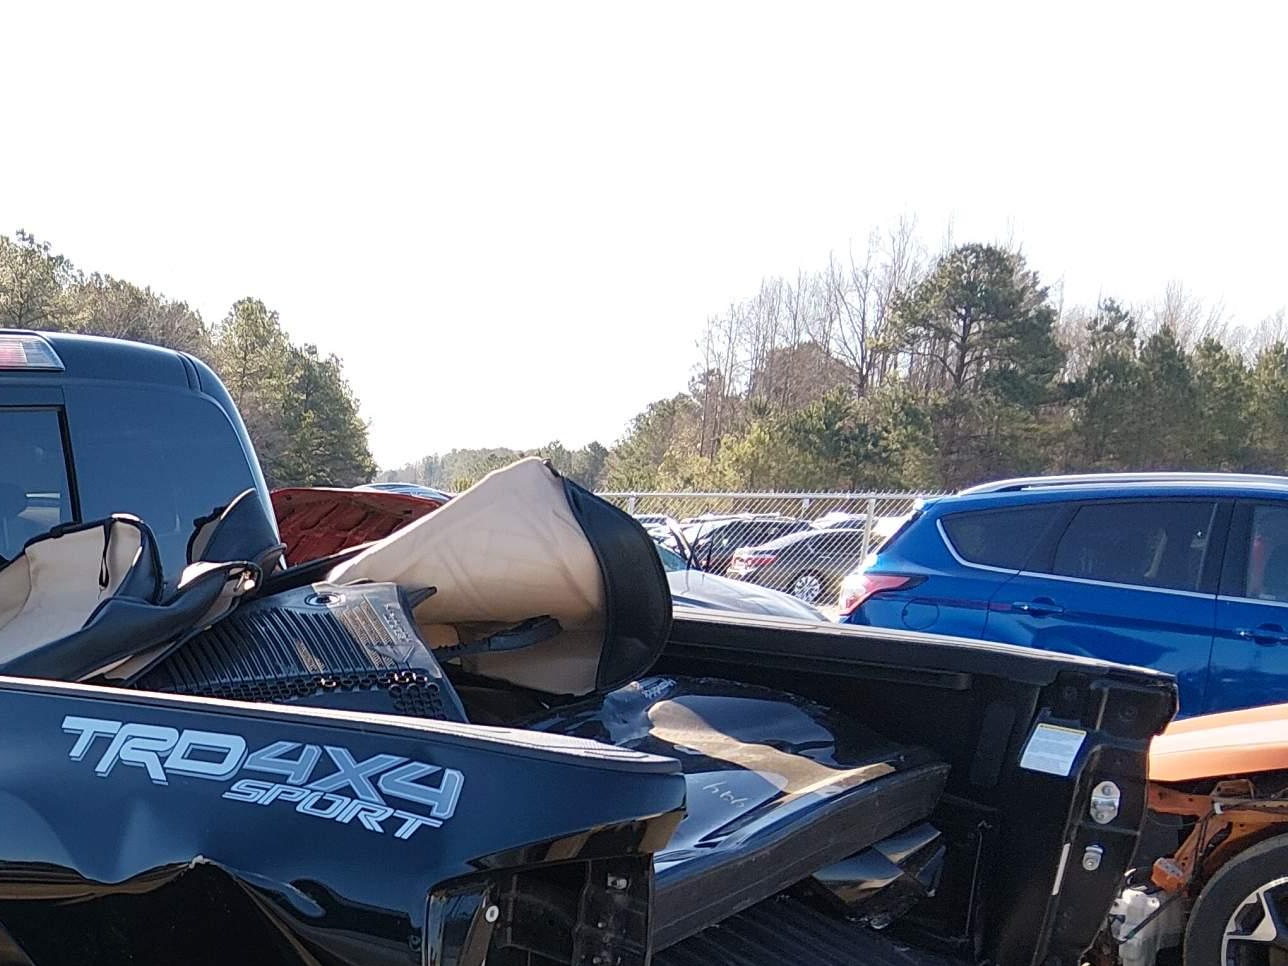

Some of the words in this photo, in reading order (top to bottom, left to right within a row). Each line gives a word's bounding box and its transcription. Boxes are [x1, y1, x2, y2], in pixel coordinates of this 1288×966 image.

[61, 715, 249, 786] TRD
[244, 740, 465, 821] 4X4
[222, 779, 444, 840] SPORT
